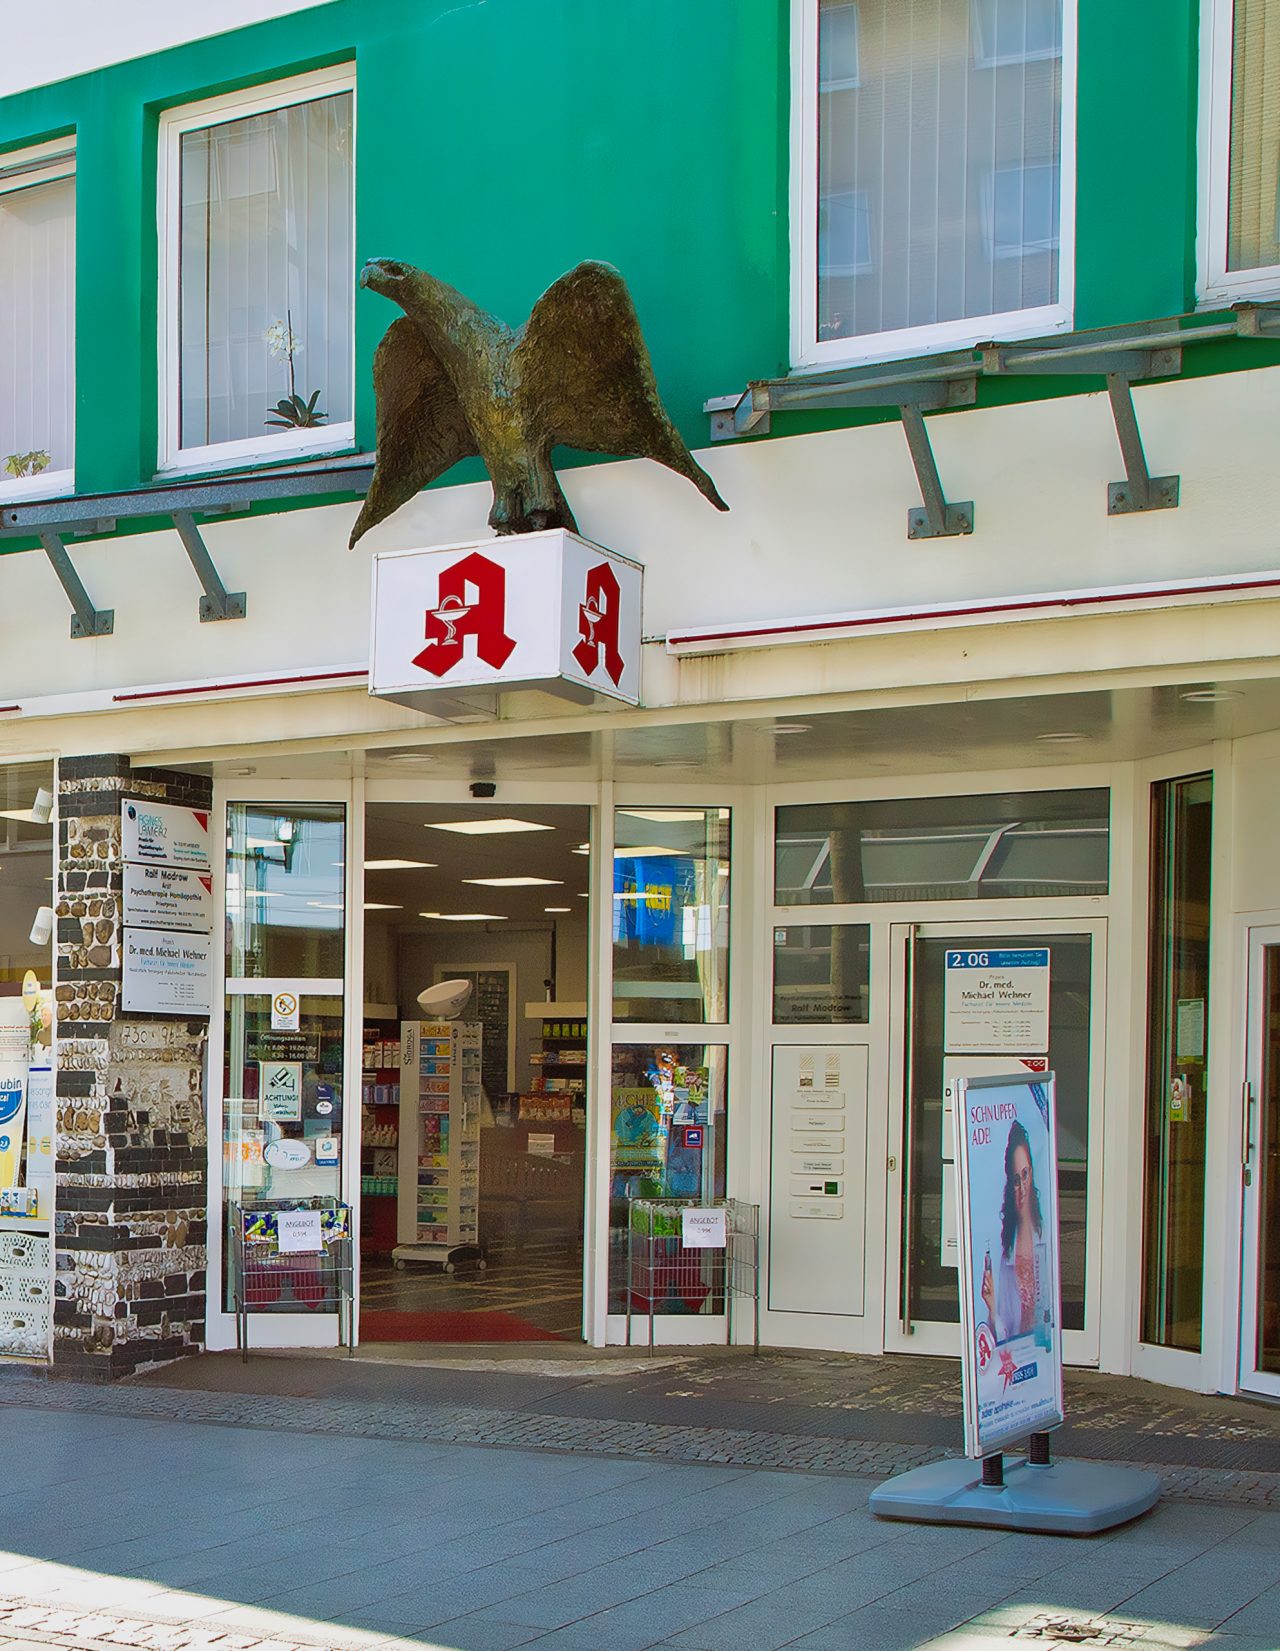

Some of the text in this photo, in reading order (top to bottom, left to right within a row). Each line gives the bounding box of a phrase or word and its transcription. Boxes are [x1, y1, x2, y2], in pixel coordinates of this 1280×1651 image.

[144, 868, 188, 881] Ralf Modrow
[129, 944, 207, 961] Dr. med. Michael Wehner
[952, 952, 990, 967] 2. OG
[979, 980, 1015, 989] Dr. med.
[961, 991, 1032, 1000] Michael Wehner
[970, 1102, 1018, 1124] SCHNUPFEN
[285, 1219, 314, 1228] ANGEBOT
[689, 1217, 719, 1225] ANGEBOT
